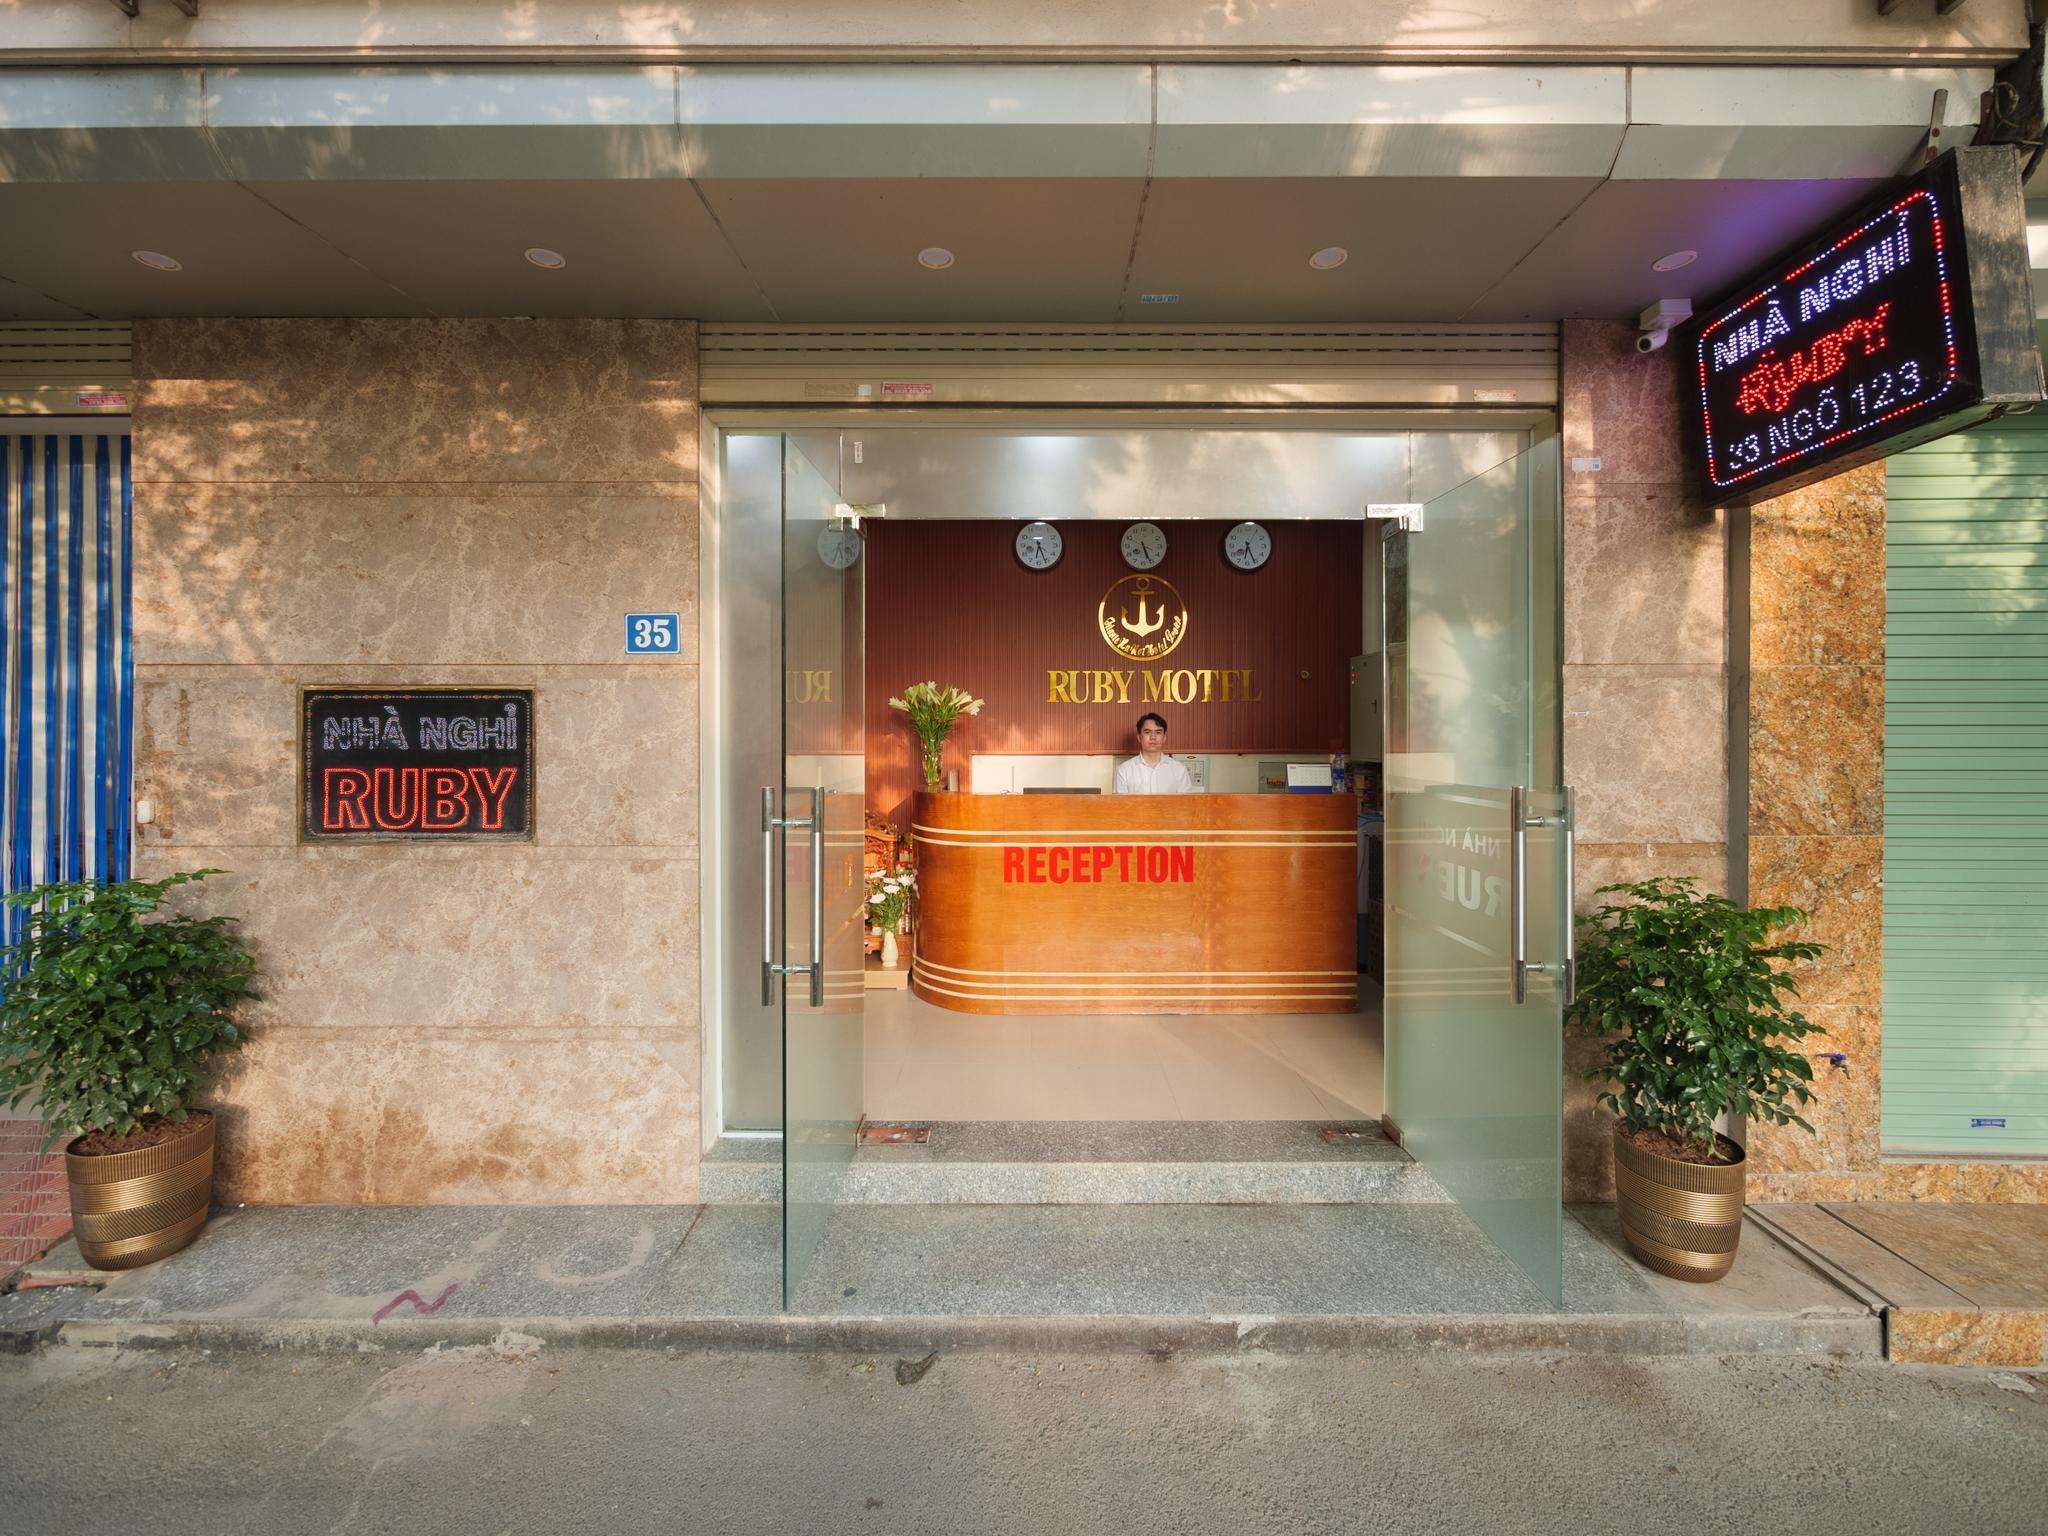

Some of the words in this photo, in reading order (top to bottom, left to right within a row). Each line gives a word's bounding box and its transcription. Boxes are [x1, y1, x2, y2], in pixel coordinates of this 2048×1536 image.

[1713, 300, 1791, 372] NHÀ
[1736, 302, 1890, 415] RUBY
[1851, 360, 1921, 415] 123
[635, 619, 671, 648] 35
[1047, 670, 1134, 704] RUBY
[1141, 669, 1263, 704] MOTEL
[322, 705, 410, 750] NHÀ
[419, 703, 518, 750] NGHỈ
[323, 767, 518, 830] RUBY
[1003, 846, 1195, 884] RECEPTION
